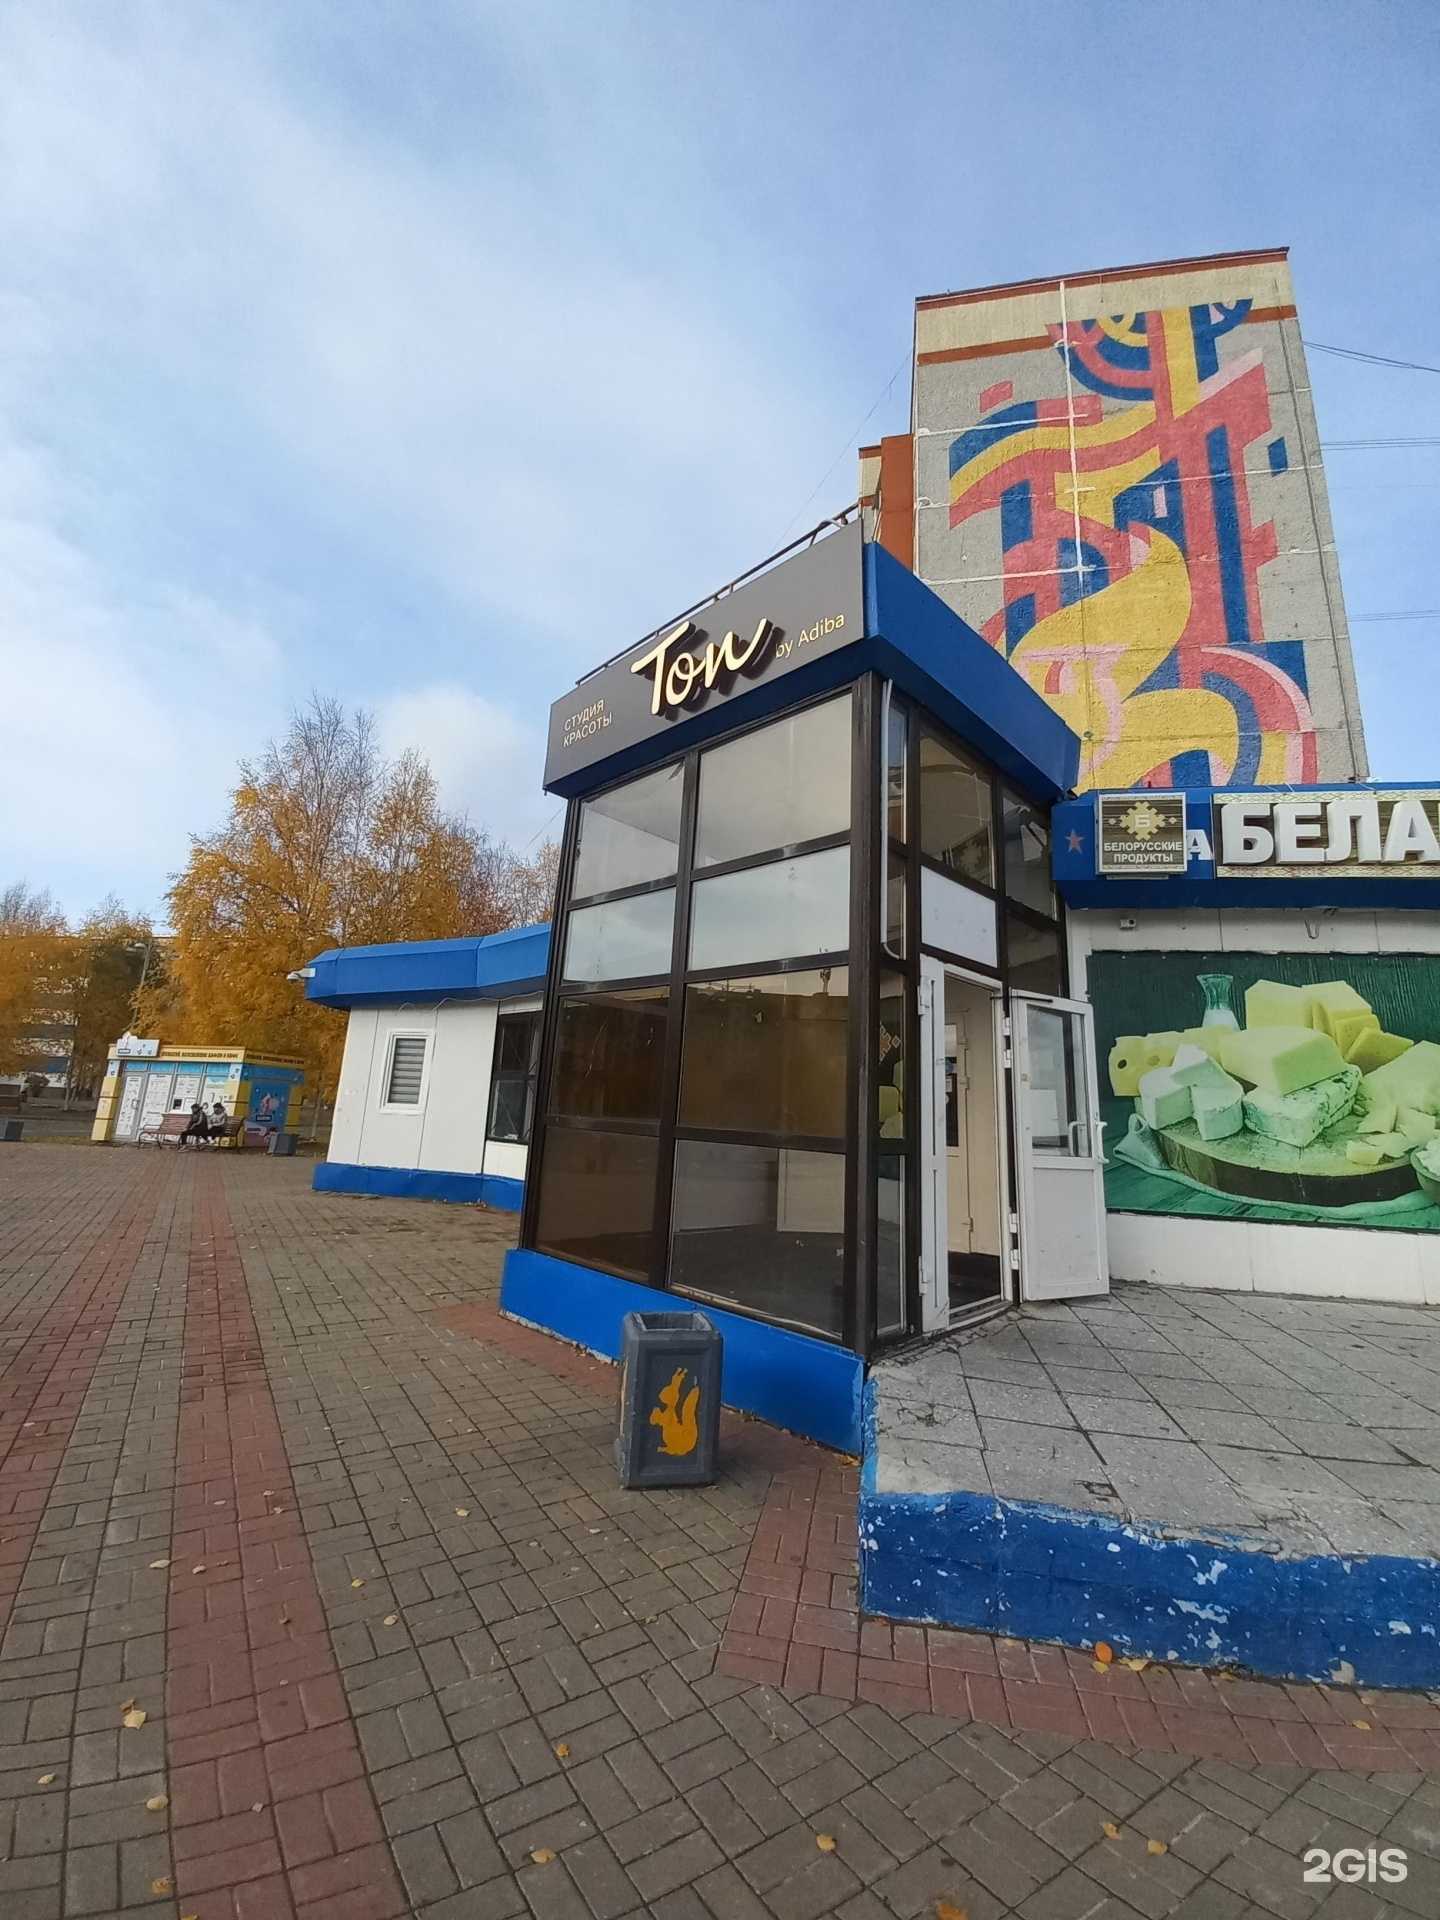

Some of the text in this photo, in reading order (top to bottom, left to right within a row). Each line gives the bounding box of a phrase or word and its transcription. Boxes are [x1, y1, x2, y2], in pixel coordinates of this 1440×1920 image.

[775, 639, 794, 659] by
[798, 614, 845, 648] Adiba
[563, 699, 604, 732] СТУДИЯ
[563, 711, 612, 748] КРАСОТЫ
[1103, 841, 1183, 852] БЕЛОРУССКИЕ
[1221, 800, 1440, 865] БЕЛА
[1113, 853, 1174, 864] ПРОДУКТЫ
